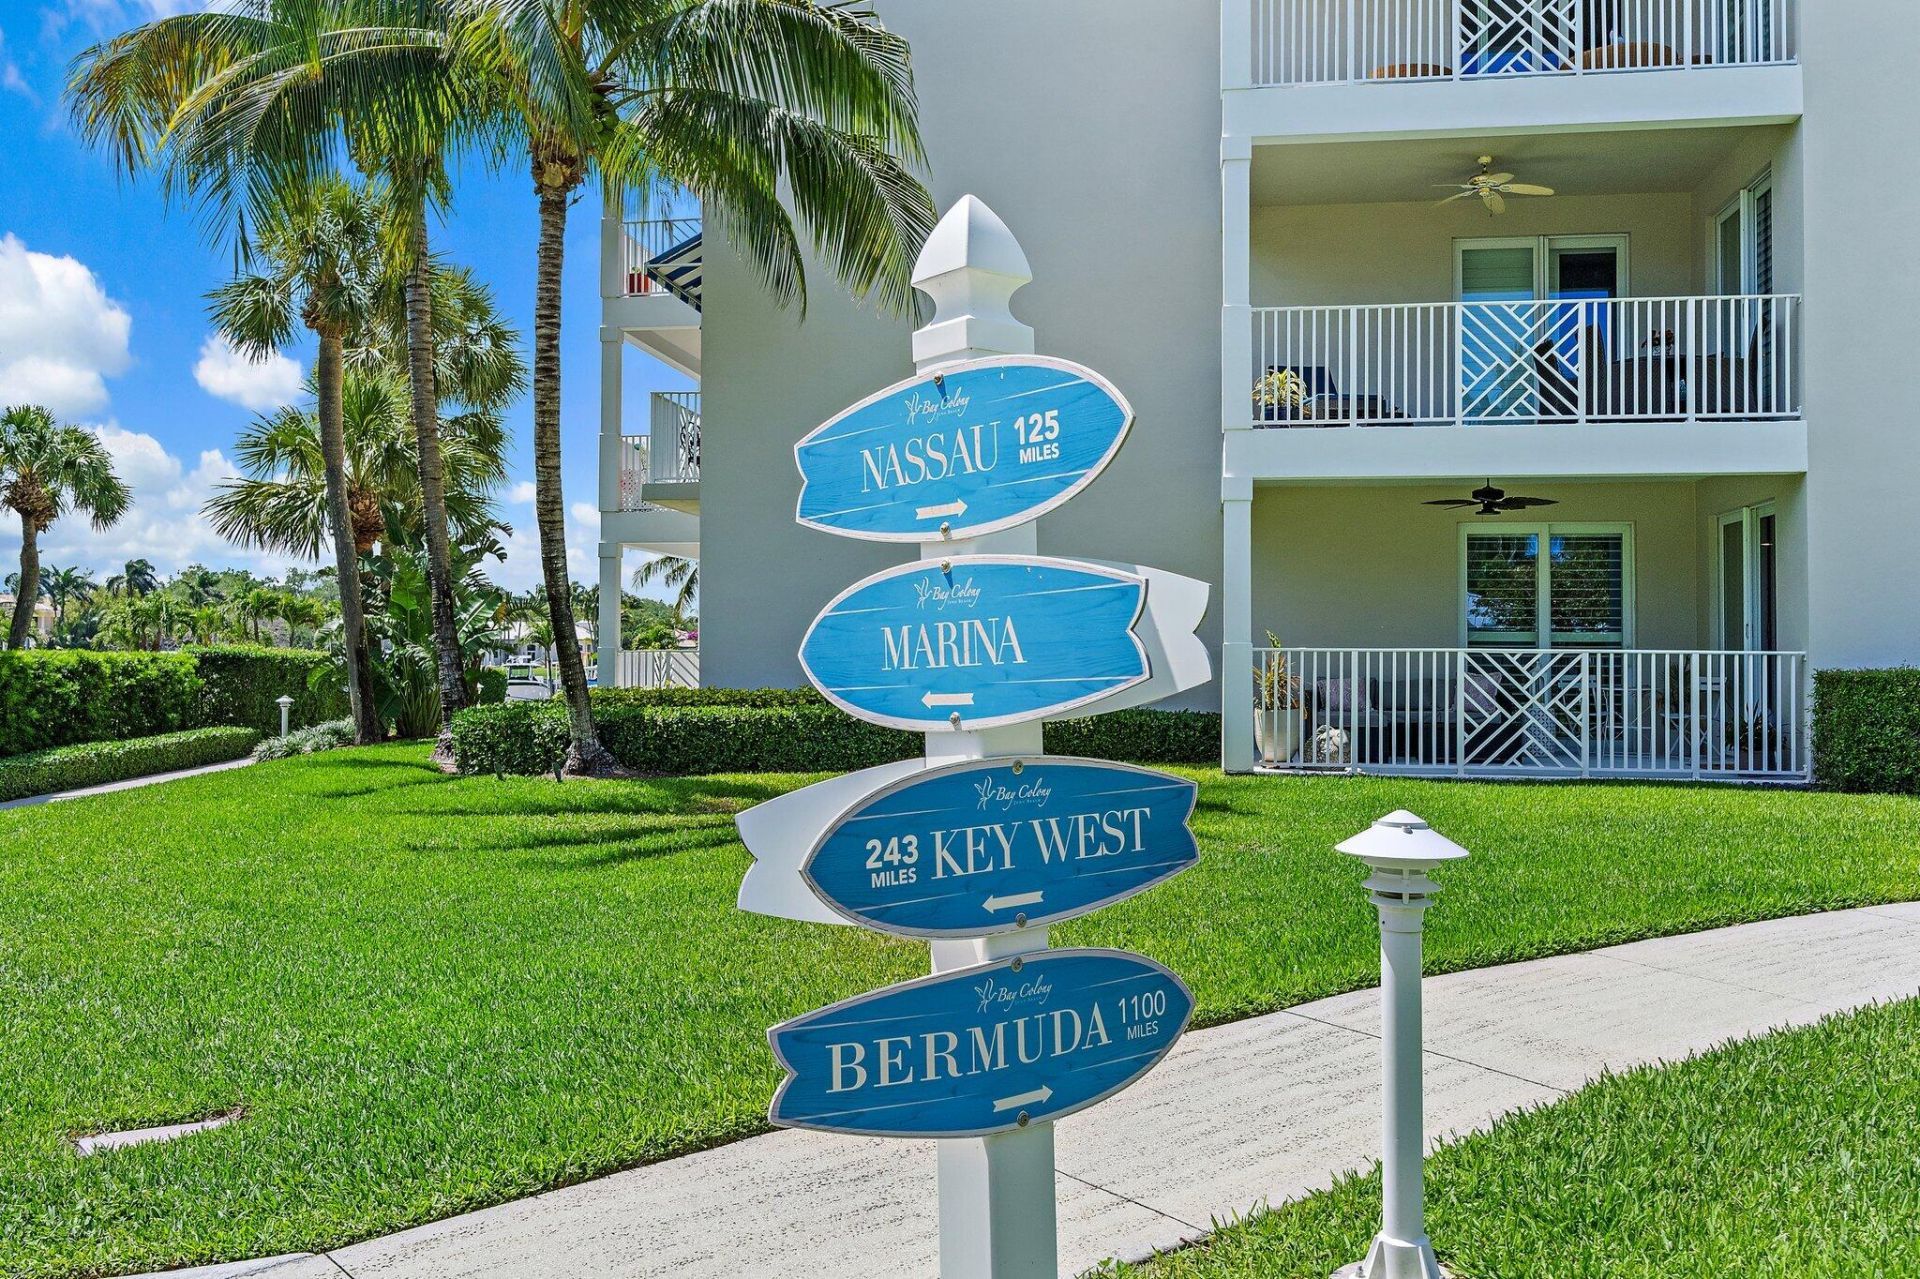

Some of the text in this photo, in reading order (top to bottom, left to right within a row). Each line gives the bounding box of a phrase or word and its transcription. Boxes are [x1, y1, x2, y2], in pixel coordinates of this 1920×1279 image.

[1014, 410, 1060, 445] 125
[860, 421, 1001, 493] NASSAU
[1019, 444, 1060, 464] MILES
[951, 576, 981, 608] Colony
[881, 615, 1028, 671] MARINA
[996, 777, 1052, 811] Bay Colony
[865, 834, 919, 870] 243
[929, 807, 1151, 880] KEY WEST
[871, 867, 917, 889] MILES
[997, 974, 1053, 1012] Bay Colony
[1118, 990, 1166, 1025] 1100
[825, 1001, 1112, 1094] BERMUDA
[1127, 1020, 1159, 1041] MILES
